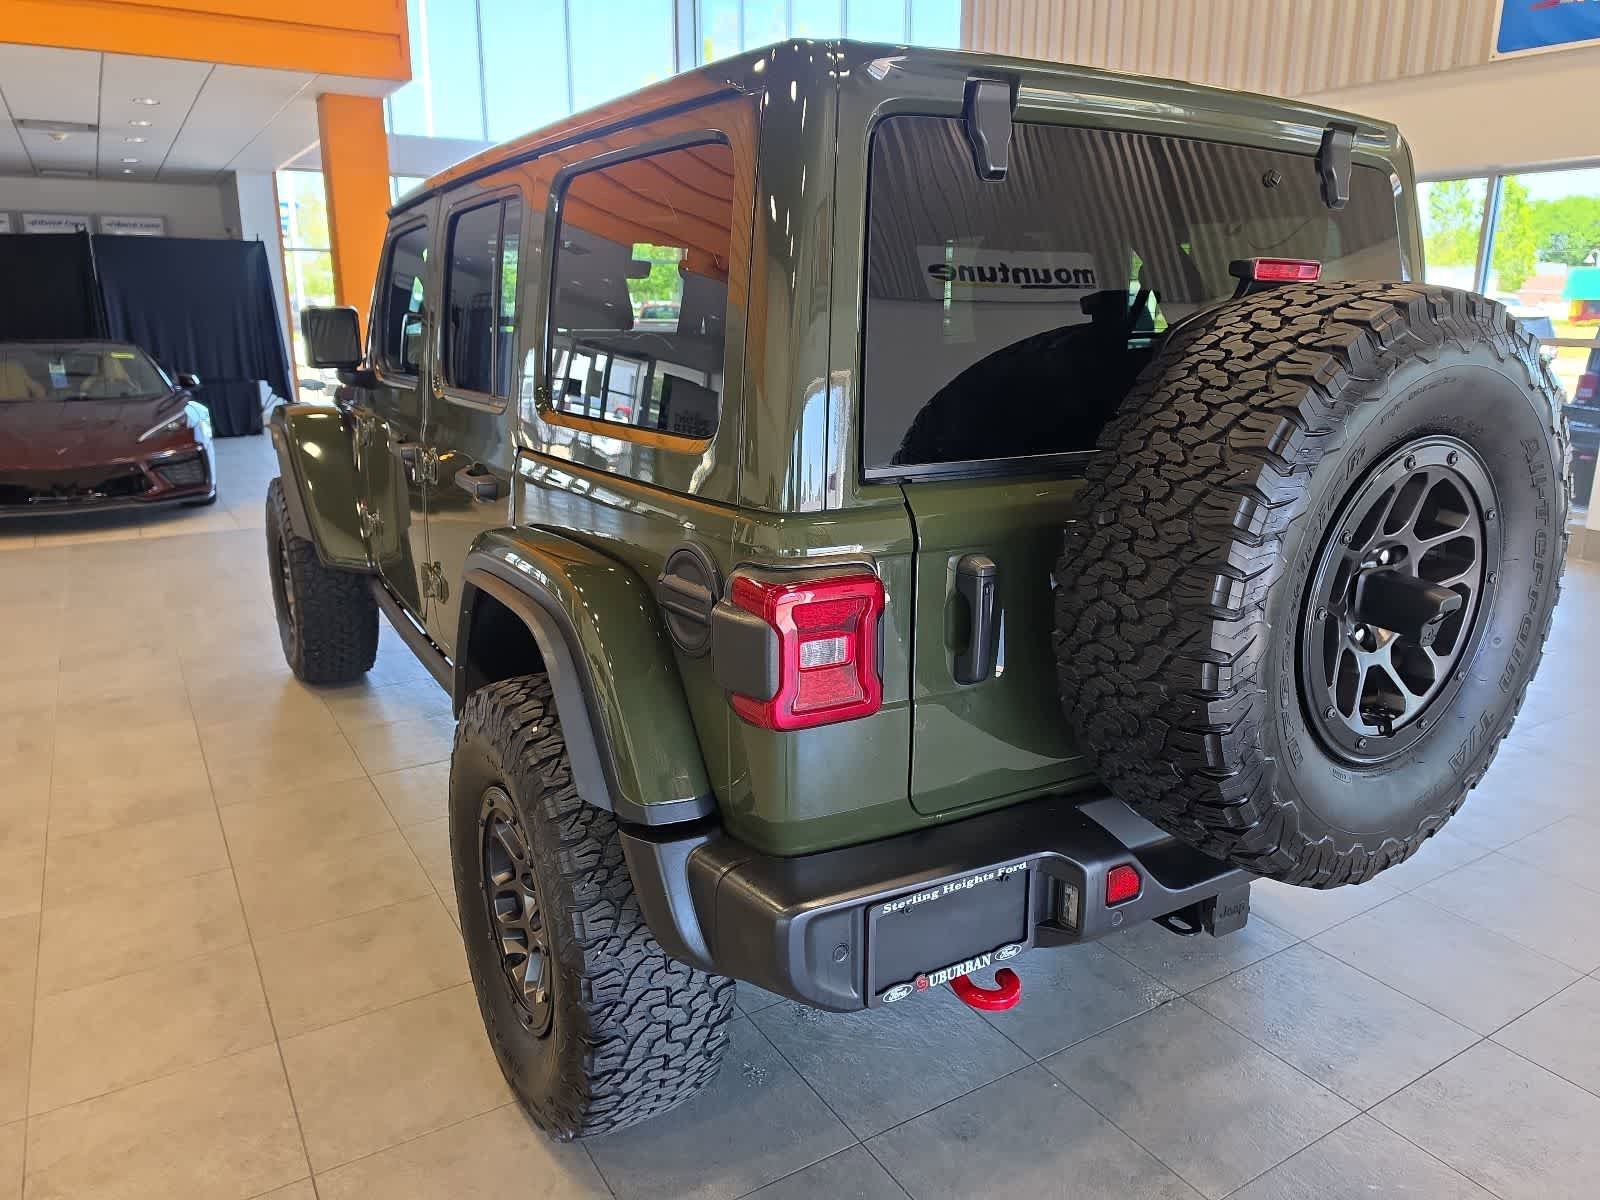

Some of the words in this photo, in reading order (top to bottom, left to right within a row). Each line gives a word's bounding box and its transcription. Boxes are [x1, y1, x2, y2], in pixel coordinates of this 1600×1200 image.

[882, 889, 940, 915] Sterling
[943, 873, 994, 894] Heights
[997, 862, 1027, 877] Ford
[916, 953, 992, 990] SUBURBAN
